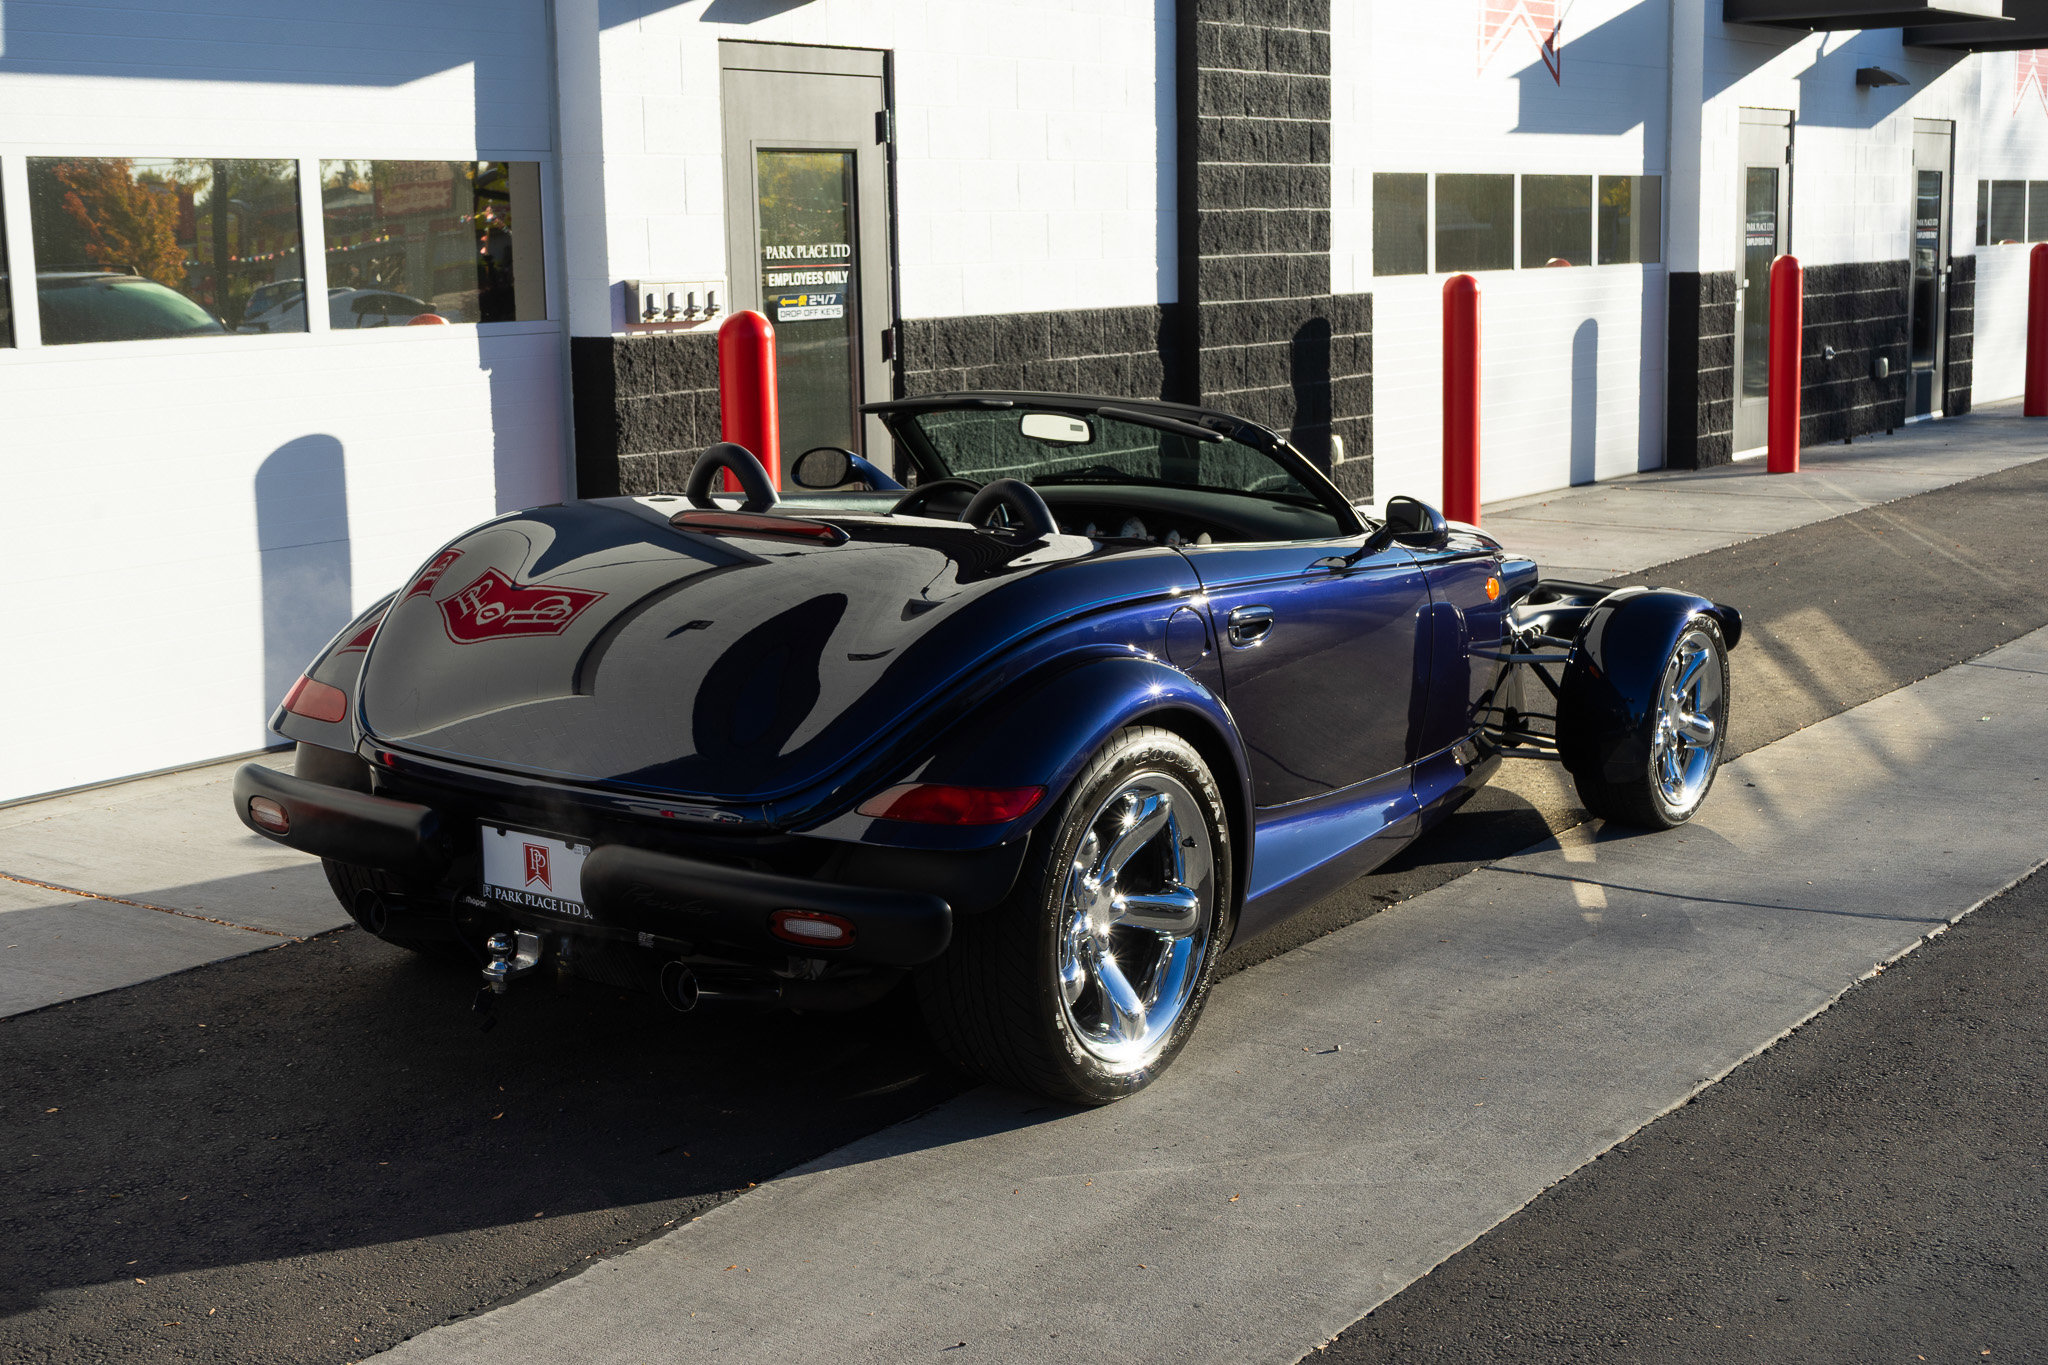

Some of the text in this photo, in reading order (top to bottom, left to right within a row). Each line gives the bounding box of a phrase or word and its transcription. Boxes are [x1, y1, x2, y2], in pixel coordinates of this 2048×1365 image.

[766, 244, 851, 260] PARK PLACE LTD
[768, 270, 849, 287] EMPLOYEES ONLY
[808, 294, 837, 306] 24/7
[780, 307, 841, 319] DROP OFF KEYS
[495, 887, 525, 904] PARK
[525, 894, 558, 911] PLACE
[560, 901, 581, 916] LTD
